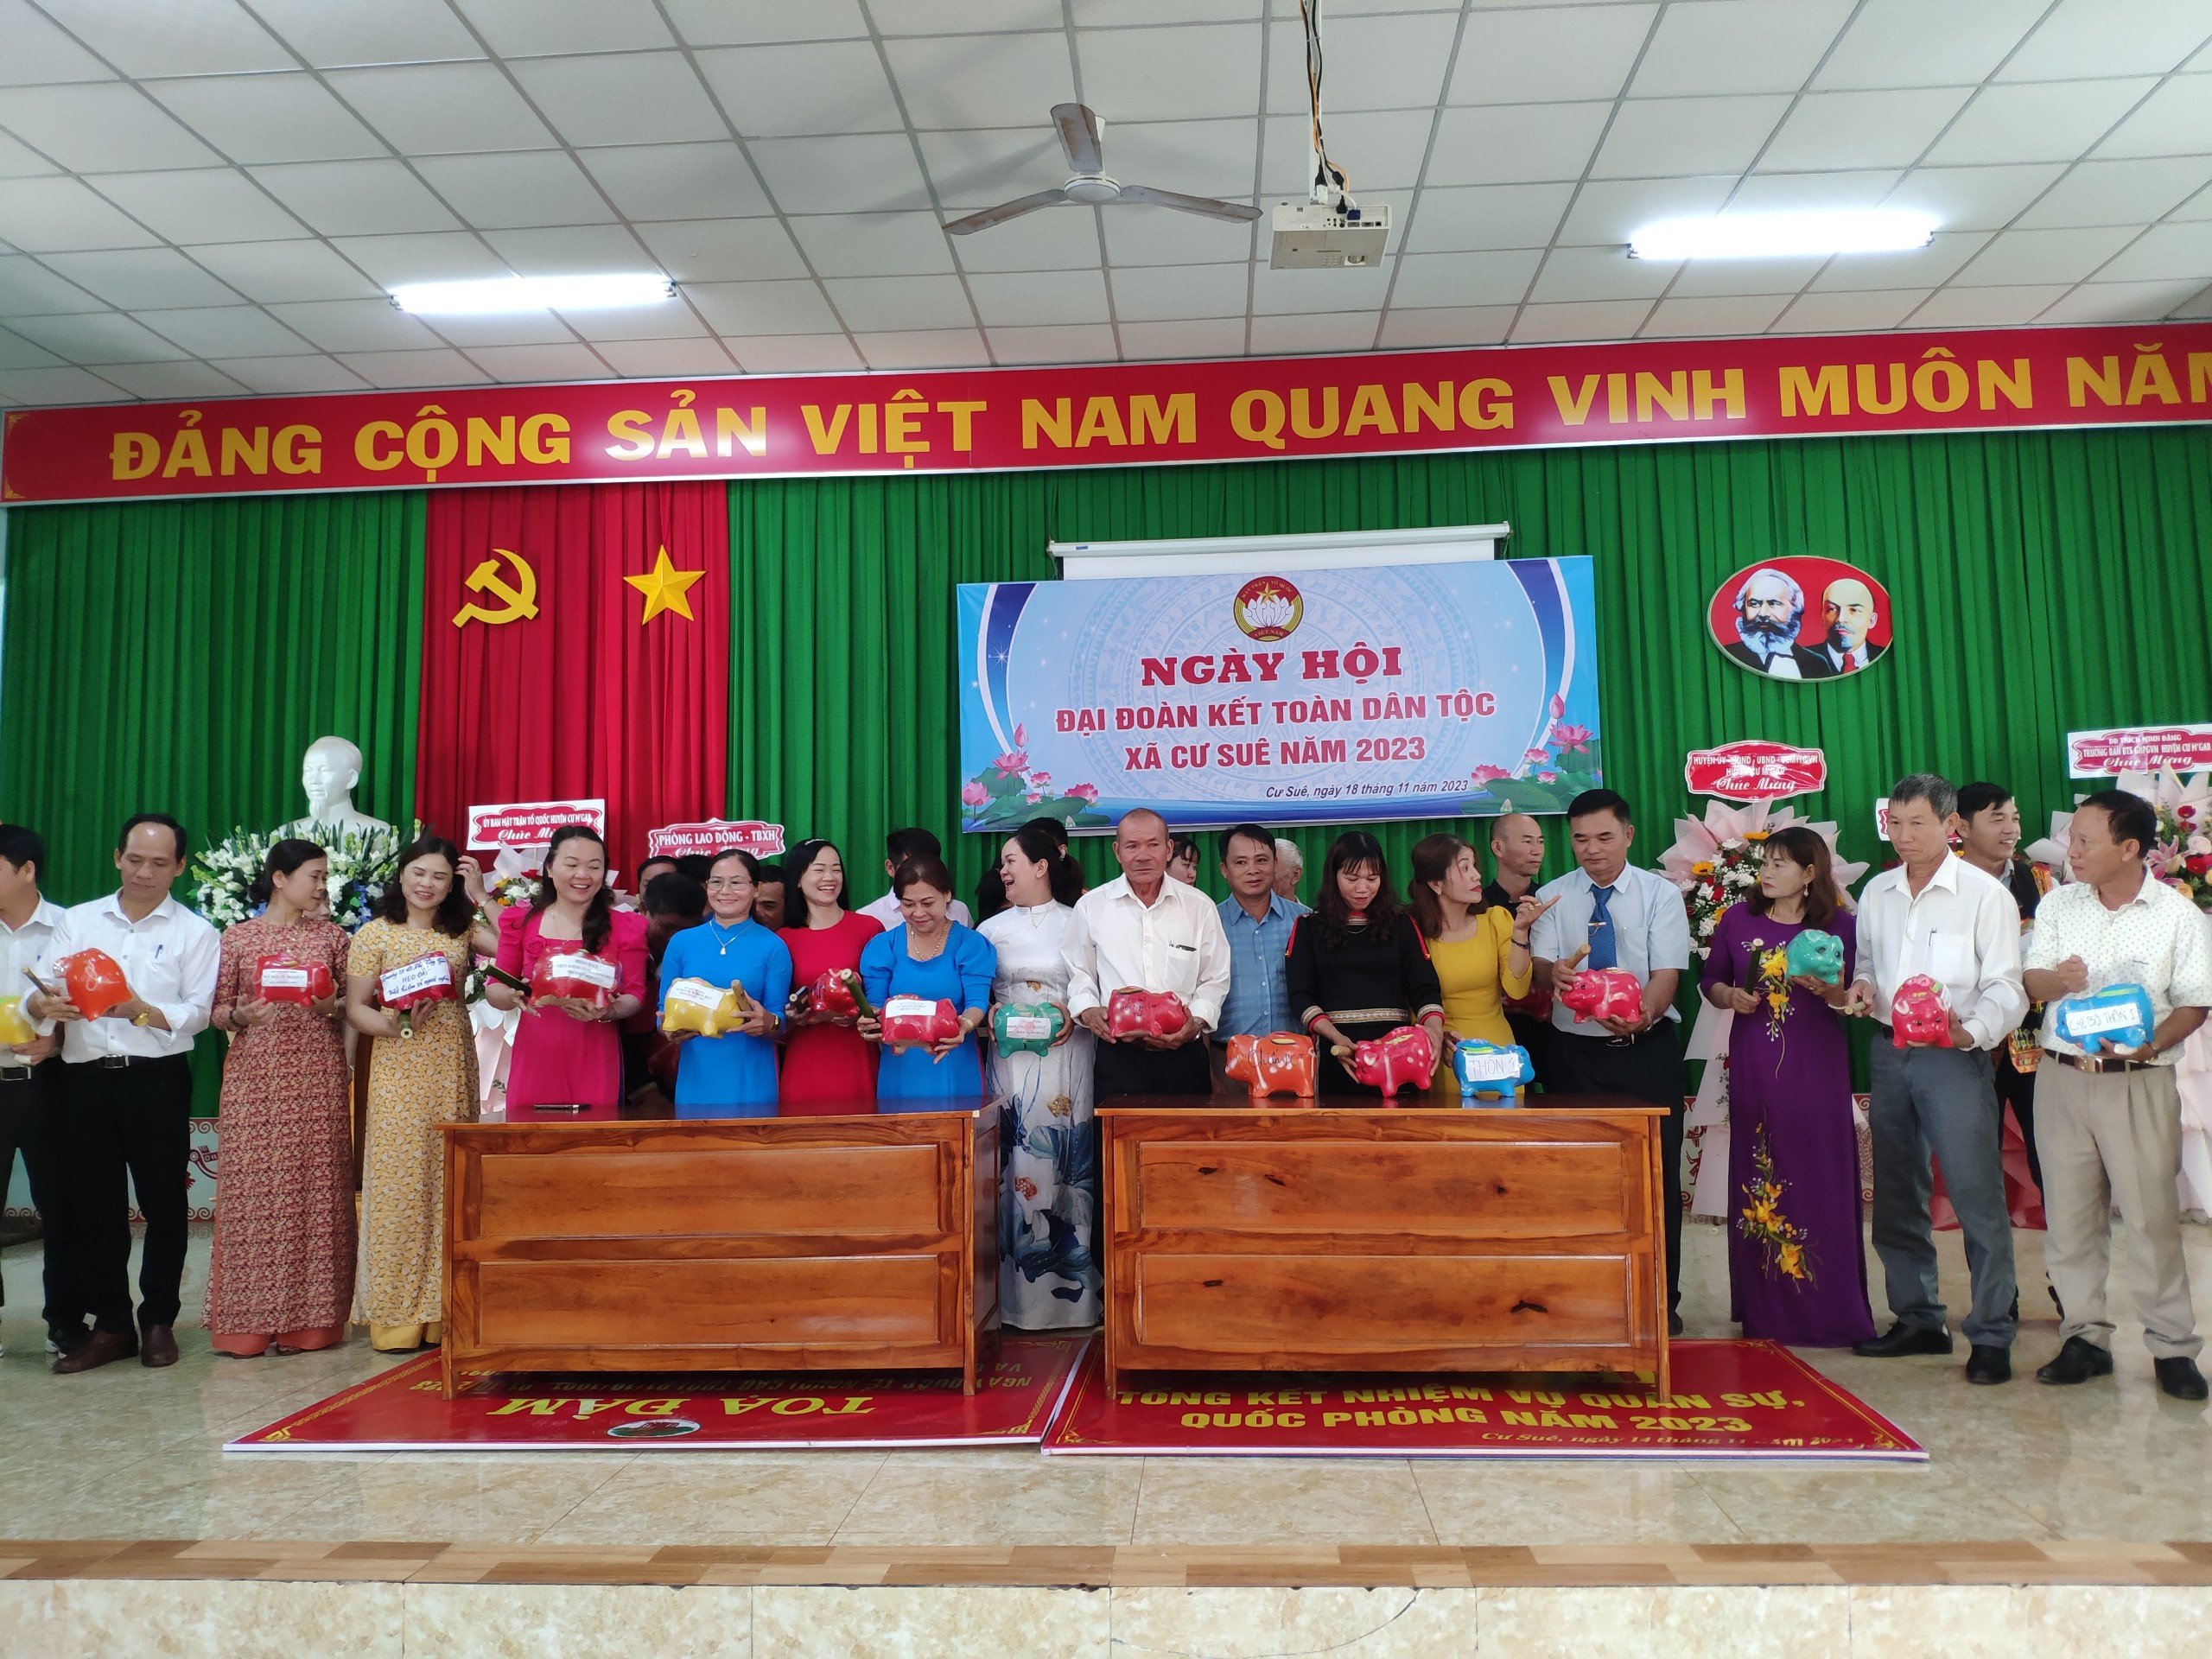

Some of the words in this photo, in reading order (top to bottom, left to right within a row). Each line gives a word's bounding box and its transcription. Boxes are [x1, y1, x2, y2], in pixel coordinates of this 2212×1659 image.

[109, 410, 323, 482] ĐẢNG
[354, 404, 572, 484] CỘNG
[606, 389, 768, 464] SẢN
[800, 389, 988, 469] VIỆT
[1021, 392, 1198, 450] NAM
[1230, 378, 1516, 450] QUANG
[1548, 368, 1746, 427] VINH
[1779, 346, 2033, 417] MUÔN
[1141, 648, 1285, 687] NGÀY
[1301, 642, 1402, 684] HỘI
[1056, 709, 1106, 737] ĐẠI
[1116, 702, 1198, 730] ĐOÀN
[1208, 696, 1262, 727] KẾT
[1272, 695, 1352, 724] TOÀN
[1363, 692, 1426, 721] DÂN
[1436, 689, 1495, 722] TỘC
[1125, 742, 1162, 771] XÃ
[1171, 742, 1211, 769] CƯ
[1217, 737, 1271, 766] SUÊ
[1281, 736, 1346, 765] NĂM
[1356, 737, 1425, 762] 2023
[1757, 755, 1776, 765] UBND
[1266, 786, 1285, 798] Cư
[1285, 785, 1310, 798] Suê,
[1313, 784, 1343, 799] ngày
[1345, 784, 1359, 796] 18
[1361, 782, 1394, 797] tháng
[1397, 782, 1409, 794] 11
[1412, 781, 1438, 793] năm
[1440, 780, 1469, 792] 2023
[658, 831, 693, 847] PHÒNG
[695, 833, 713, 845] LAO
[715, 830, 743, 845] ĐỘNG
[750, 830, 775, 842] TBXH
[1469, 1056, 1504, 1077] THÔN
[1247, 1386, 1328, 1406] KẾT
[1342, 1382, 1494, 1404] NHIỆM
[1503, 1388, 1567, 1408] VỤ
[1180, 1408, 1306, 1428] QUỐC
[1322, 1406, 1489, 1427] PHÒNG
[1499, 1409, 1619, 1430] NĂM
[1629, 1415, 1753, 1433] 2023
